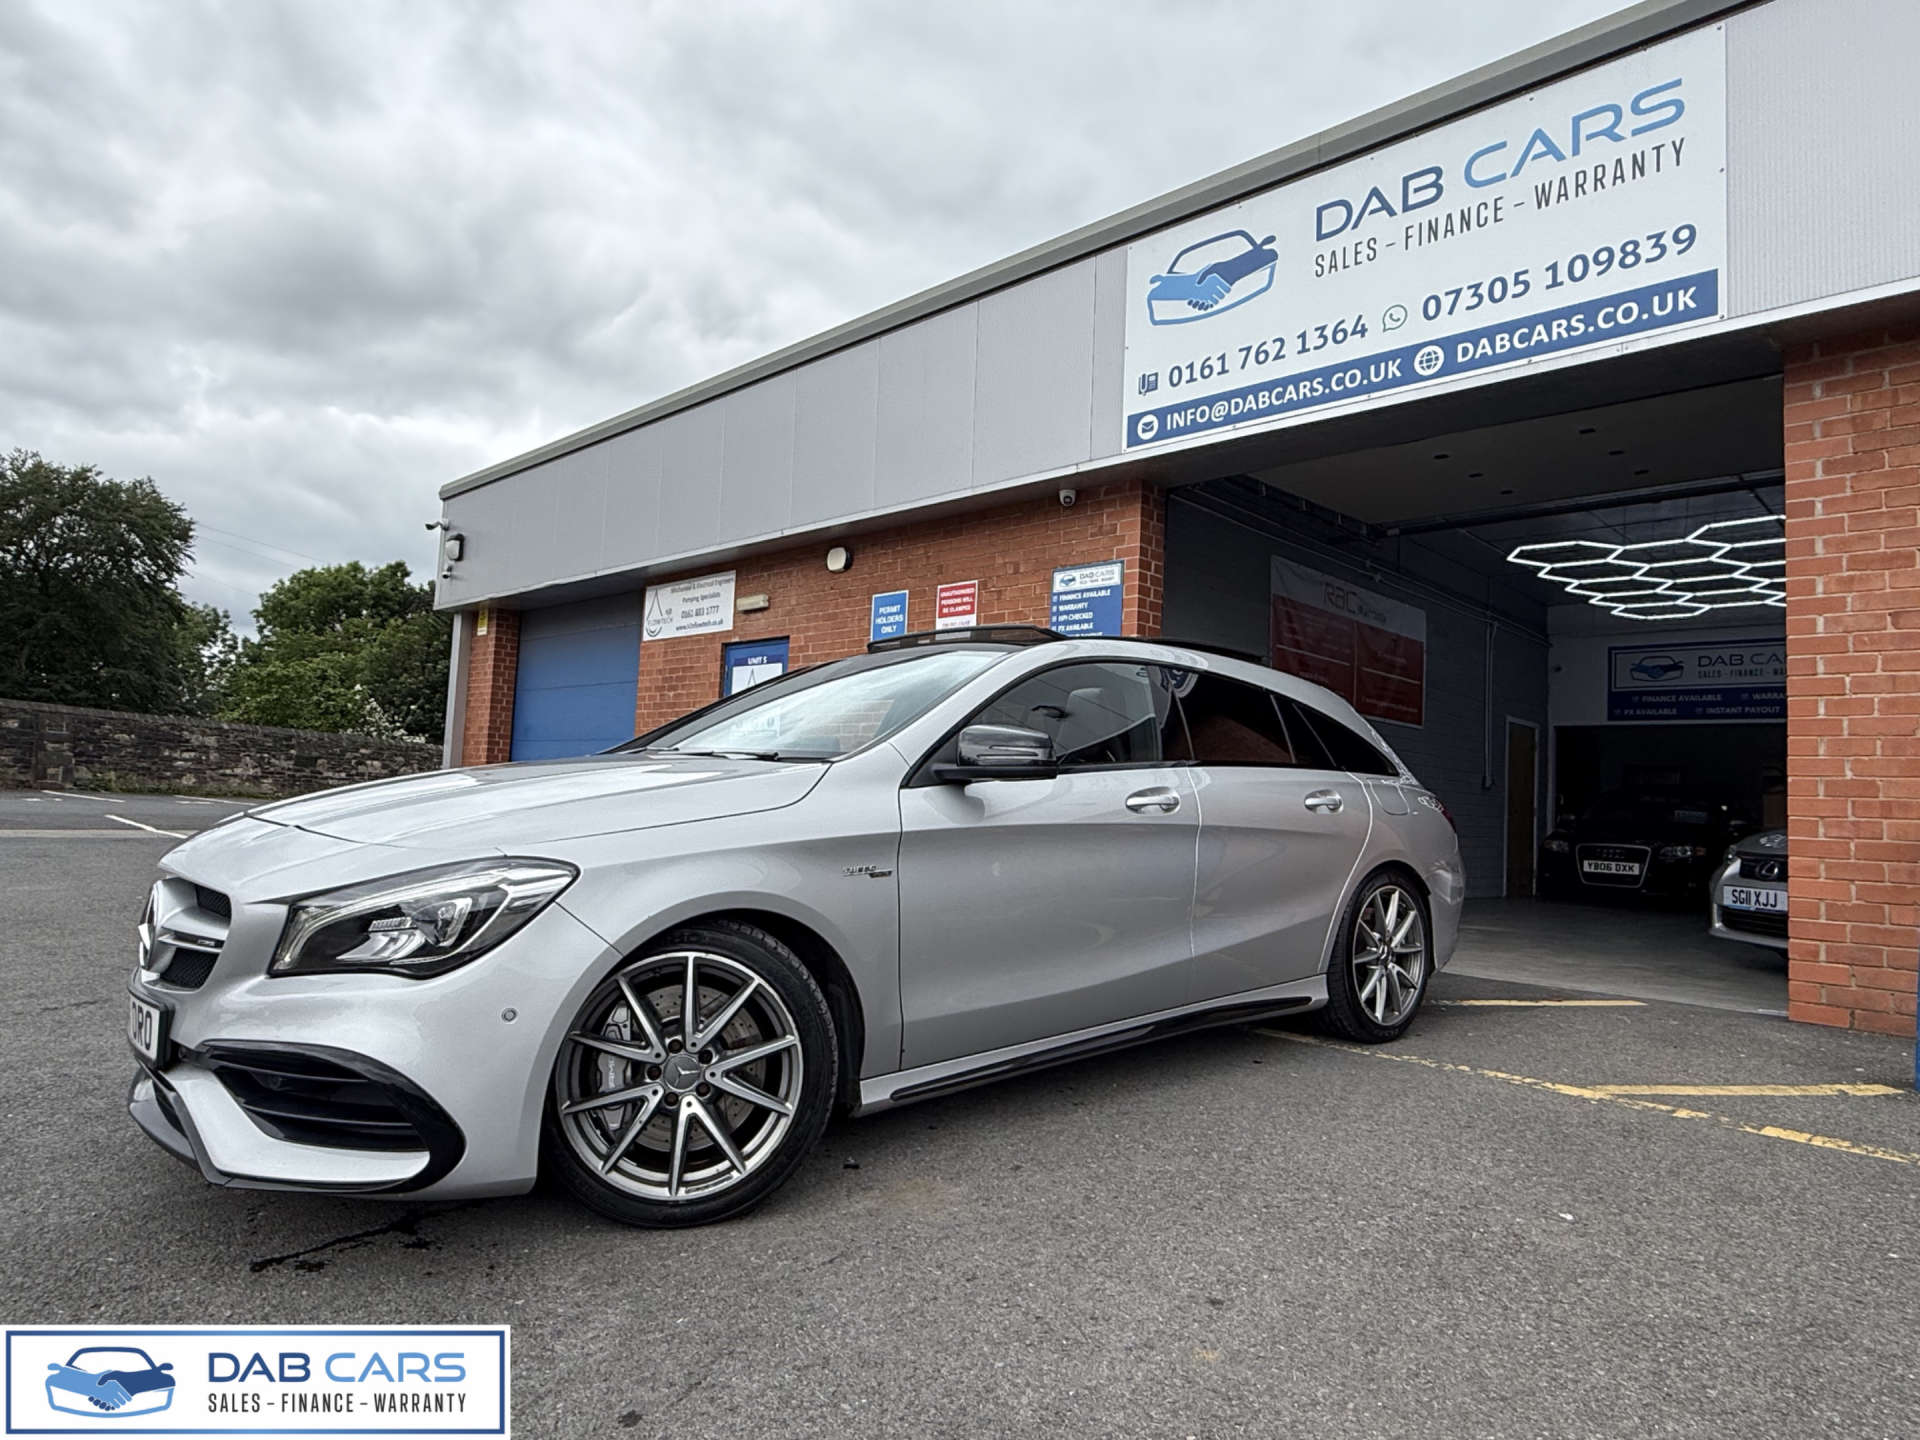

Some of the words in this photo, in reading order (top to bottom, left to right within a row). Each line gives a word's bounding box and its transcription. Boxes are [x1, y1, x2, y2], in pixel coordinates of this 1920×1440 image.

[1315, 165, 1444, 241] DAB
[1463, 77, 1685, 189] CARS
[1314, 238, 1378, 279] SALES
[1404, 196, 1504, 251] FINANCE
[1533, 137, 1686, 210] WARRANTY
[1168, 354, 1229, 389] 0161
[1238, 337, 1287, 371] 762
[1296, 314, 1369, 355] 1364
[1422, 269, 1531, 322] 07305
[1544, 222, 1697, 290] 109839
[1166, 357, 1402, 430] INFO@DABCARS.CO.UK
[1456, 286, 1698, 364] DABCARS.CO.UK
[879, 604, 901, 614] PERMIT
[875, 614, 904, 624] HOLDERS
[881, 624, 897, 634] ONLY
[1698, 654, 1744, 668] DAB
[1750, 652, 1786, 665] CA
[1752, 692, 1786, 700] WARRA
[1754, 891, 1778, 908] XJJ
